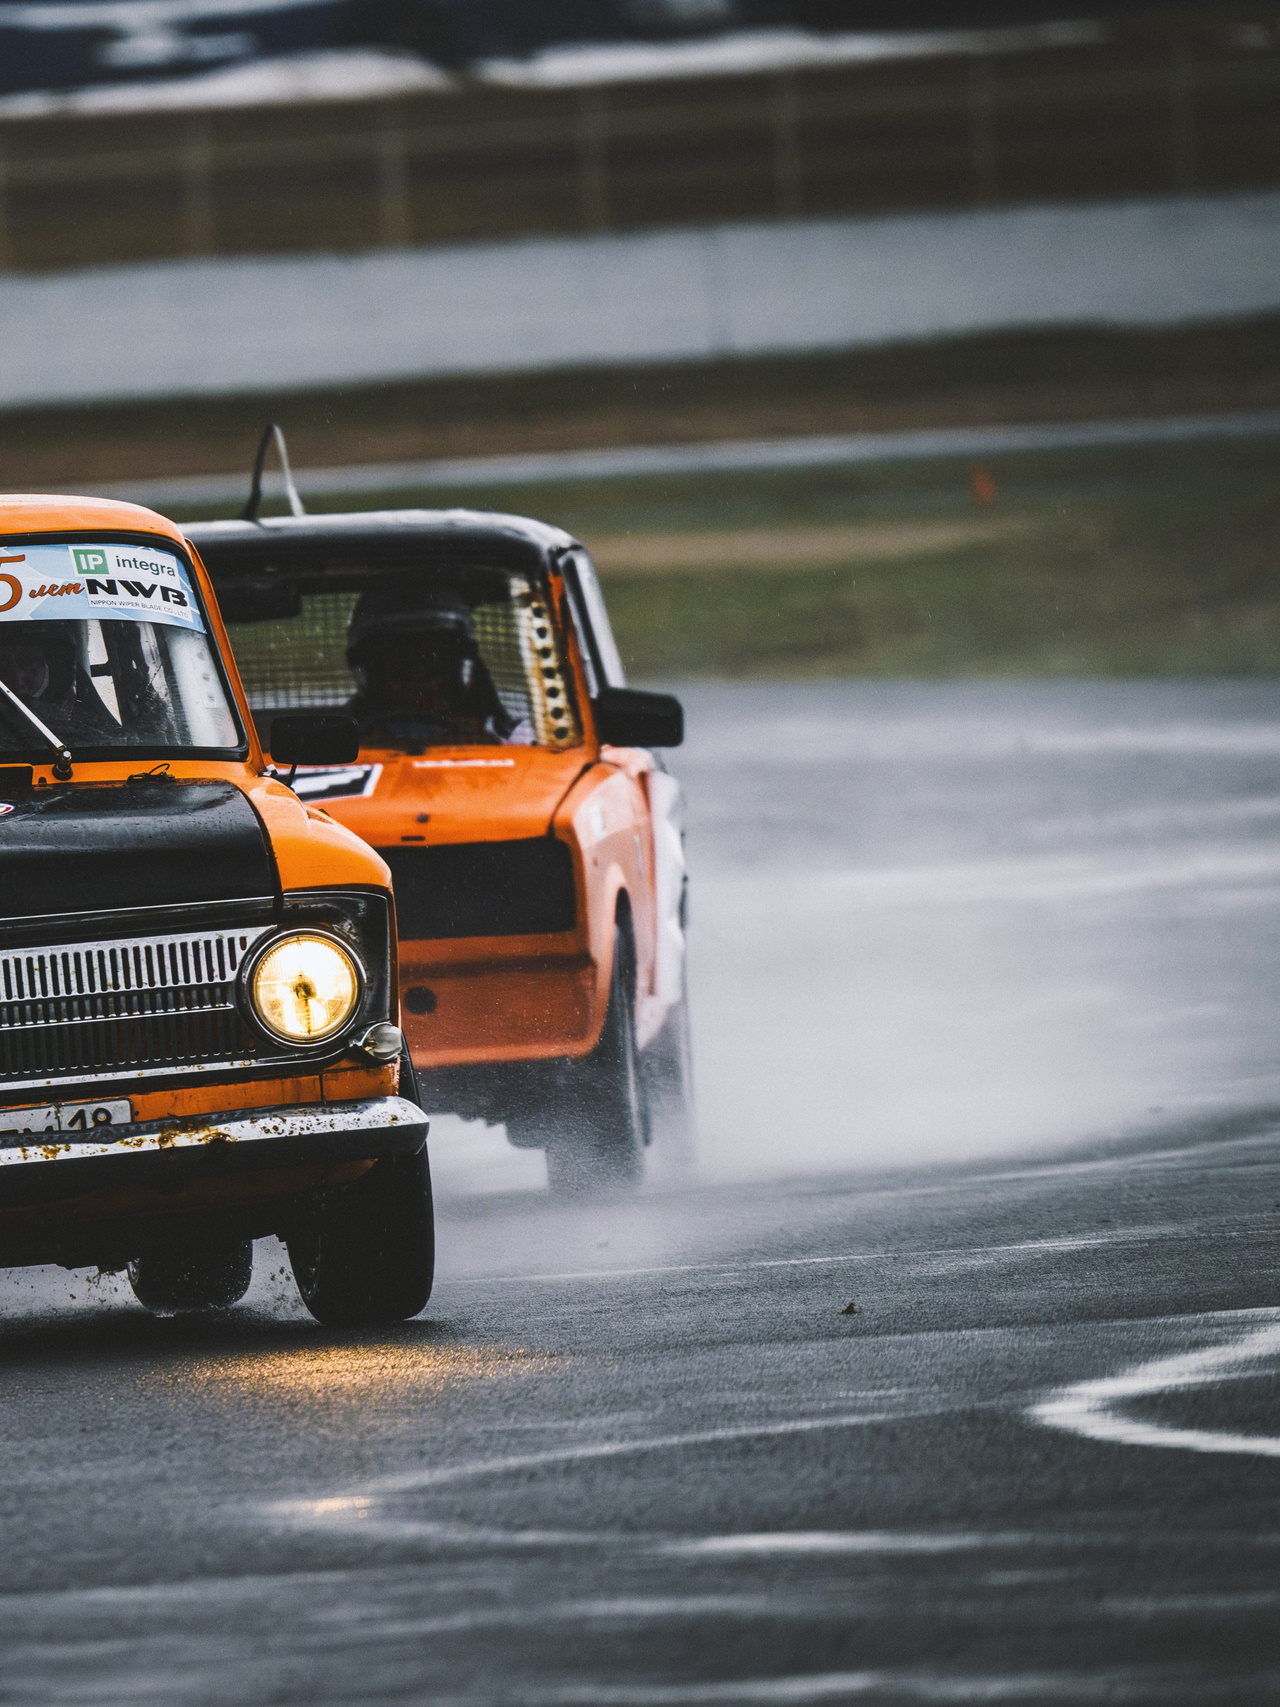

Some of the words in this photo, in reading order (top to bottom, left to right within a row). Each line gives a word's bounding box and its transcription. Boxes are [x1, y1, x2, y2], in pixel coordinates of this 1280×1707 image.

[79, 553, 103, 571] IP
[115, 555, 176, 577] integra
[28, 582, 85, 599] лет
[85, 578, 188, 607] NWB
[119, 600, 141, 608] WIPER
[141, 602, 162, 612] BLADE
